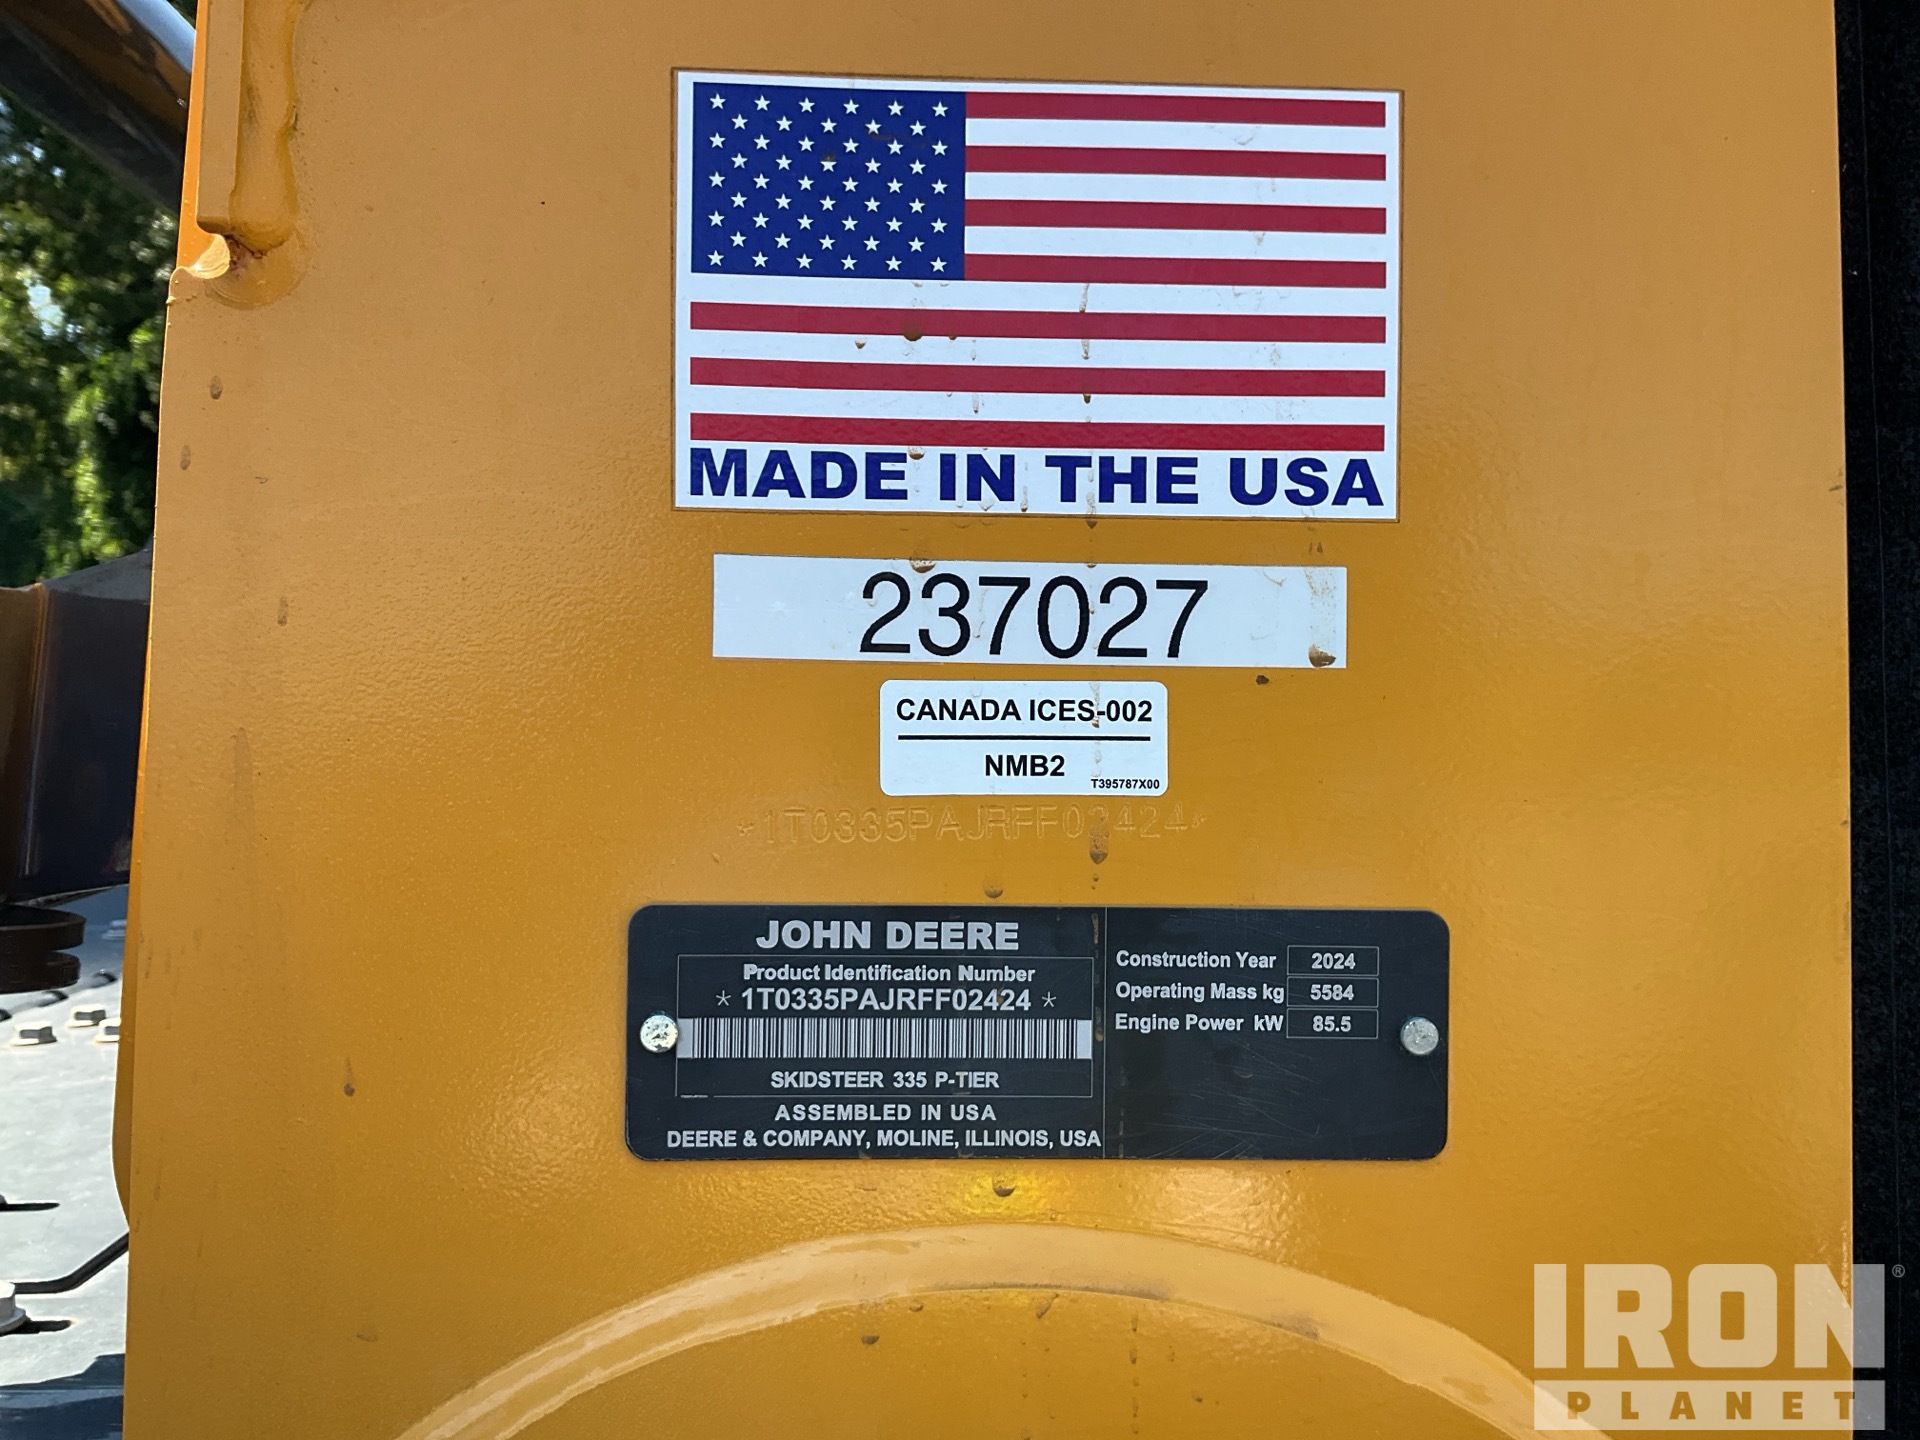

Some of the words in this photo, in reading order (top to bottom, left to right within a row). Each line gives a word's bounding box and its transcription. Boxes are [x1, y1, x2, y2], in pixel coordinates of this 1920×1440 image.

[690, 448, 908, 500] MADE
[940, 453, 1016, 501] IN
[1045, 456, 1199, 503] THE
[1229, 458, 1384, 506] USA
[860, 571, 1208, 659] 237027
[897, 699, 1021, 722] CANADA
[1029, 700, 1152, 723] ICES-002
[985, 756, 1065, 777] NMB2
[1091, 779, 1160, 790] T395787X00
[756, 921, 871, 950] JOHN
[887, 922, 1019, 950] DEERE
[1116, 951, 1231, 968] Construction
[1236, 952, 1276, 969] Year
[1312, 953, 1355, 969] 2024
[743, 964, 820, 981] Product
[825, 965, 953, 981] Identification
[958, 966, 1035, 982] Number
[741, 988, 1031, 1011] 1T0335PAJRFF02424
[1116, 982, 1205, 1002] Operating
[1210, 983, 1257, 999] Mass
[1263, 984, 1284, 1003] kg
[1311, 985, 1354, 1000] 5584
[1116, 1014, 1179, 1033] Engine
[1186, 1015, 1243, 1030] Power
[1254, 1016, 1283, 1031] kW
[1313, 1016, 1351, 1032] 85.5
[771, 1071, 884, 1088] SKIDSTEER
[893, 1072, 927, 1088] 335
[935, 1072, 999, 1088] P-TIER
[775, 1105, 911, 1121] ASSEMBLED
[921, 1105, 941, 1121] IN
[950, 1105, 996, 1121] USA
[667, 1130, 736, 1147] DEERE
[743, 1130, 757, 1147] &
[763, 1130, 870, 1150] COMPANY,
[877, 1130, 959, 1150] MOLINE,
[965, 1130, 1054, 1150] ILLINOIS,
[1060, 1130, 1100, 1147] USA
